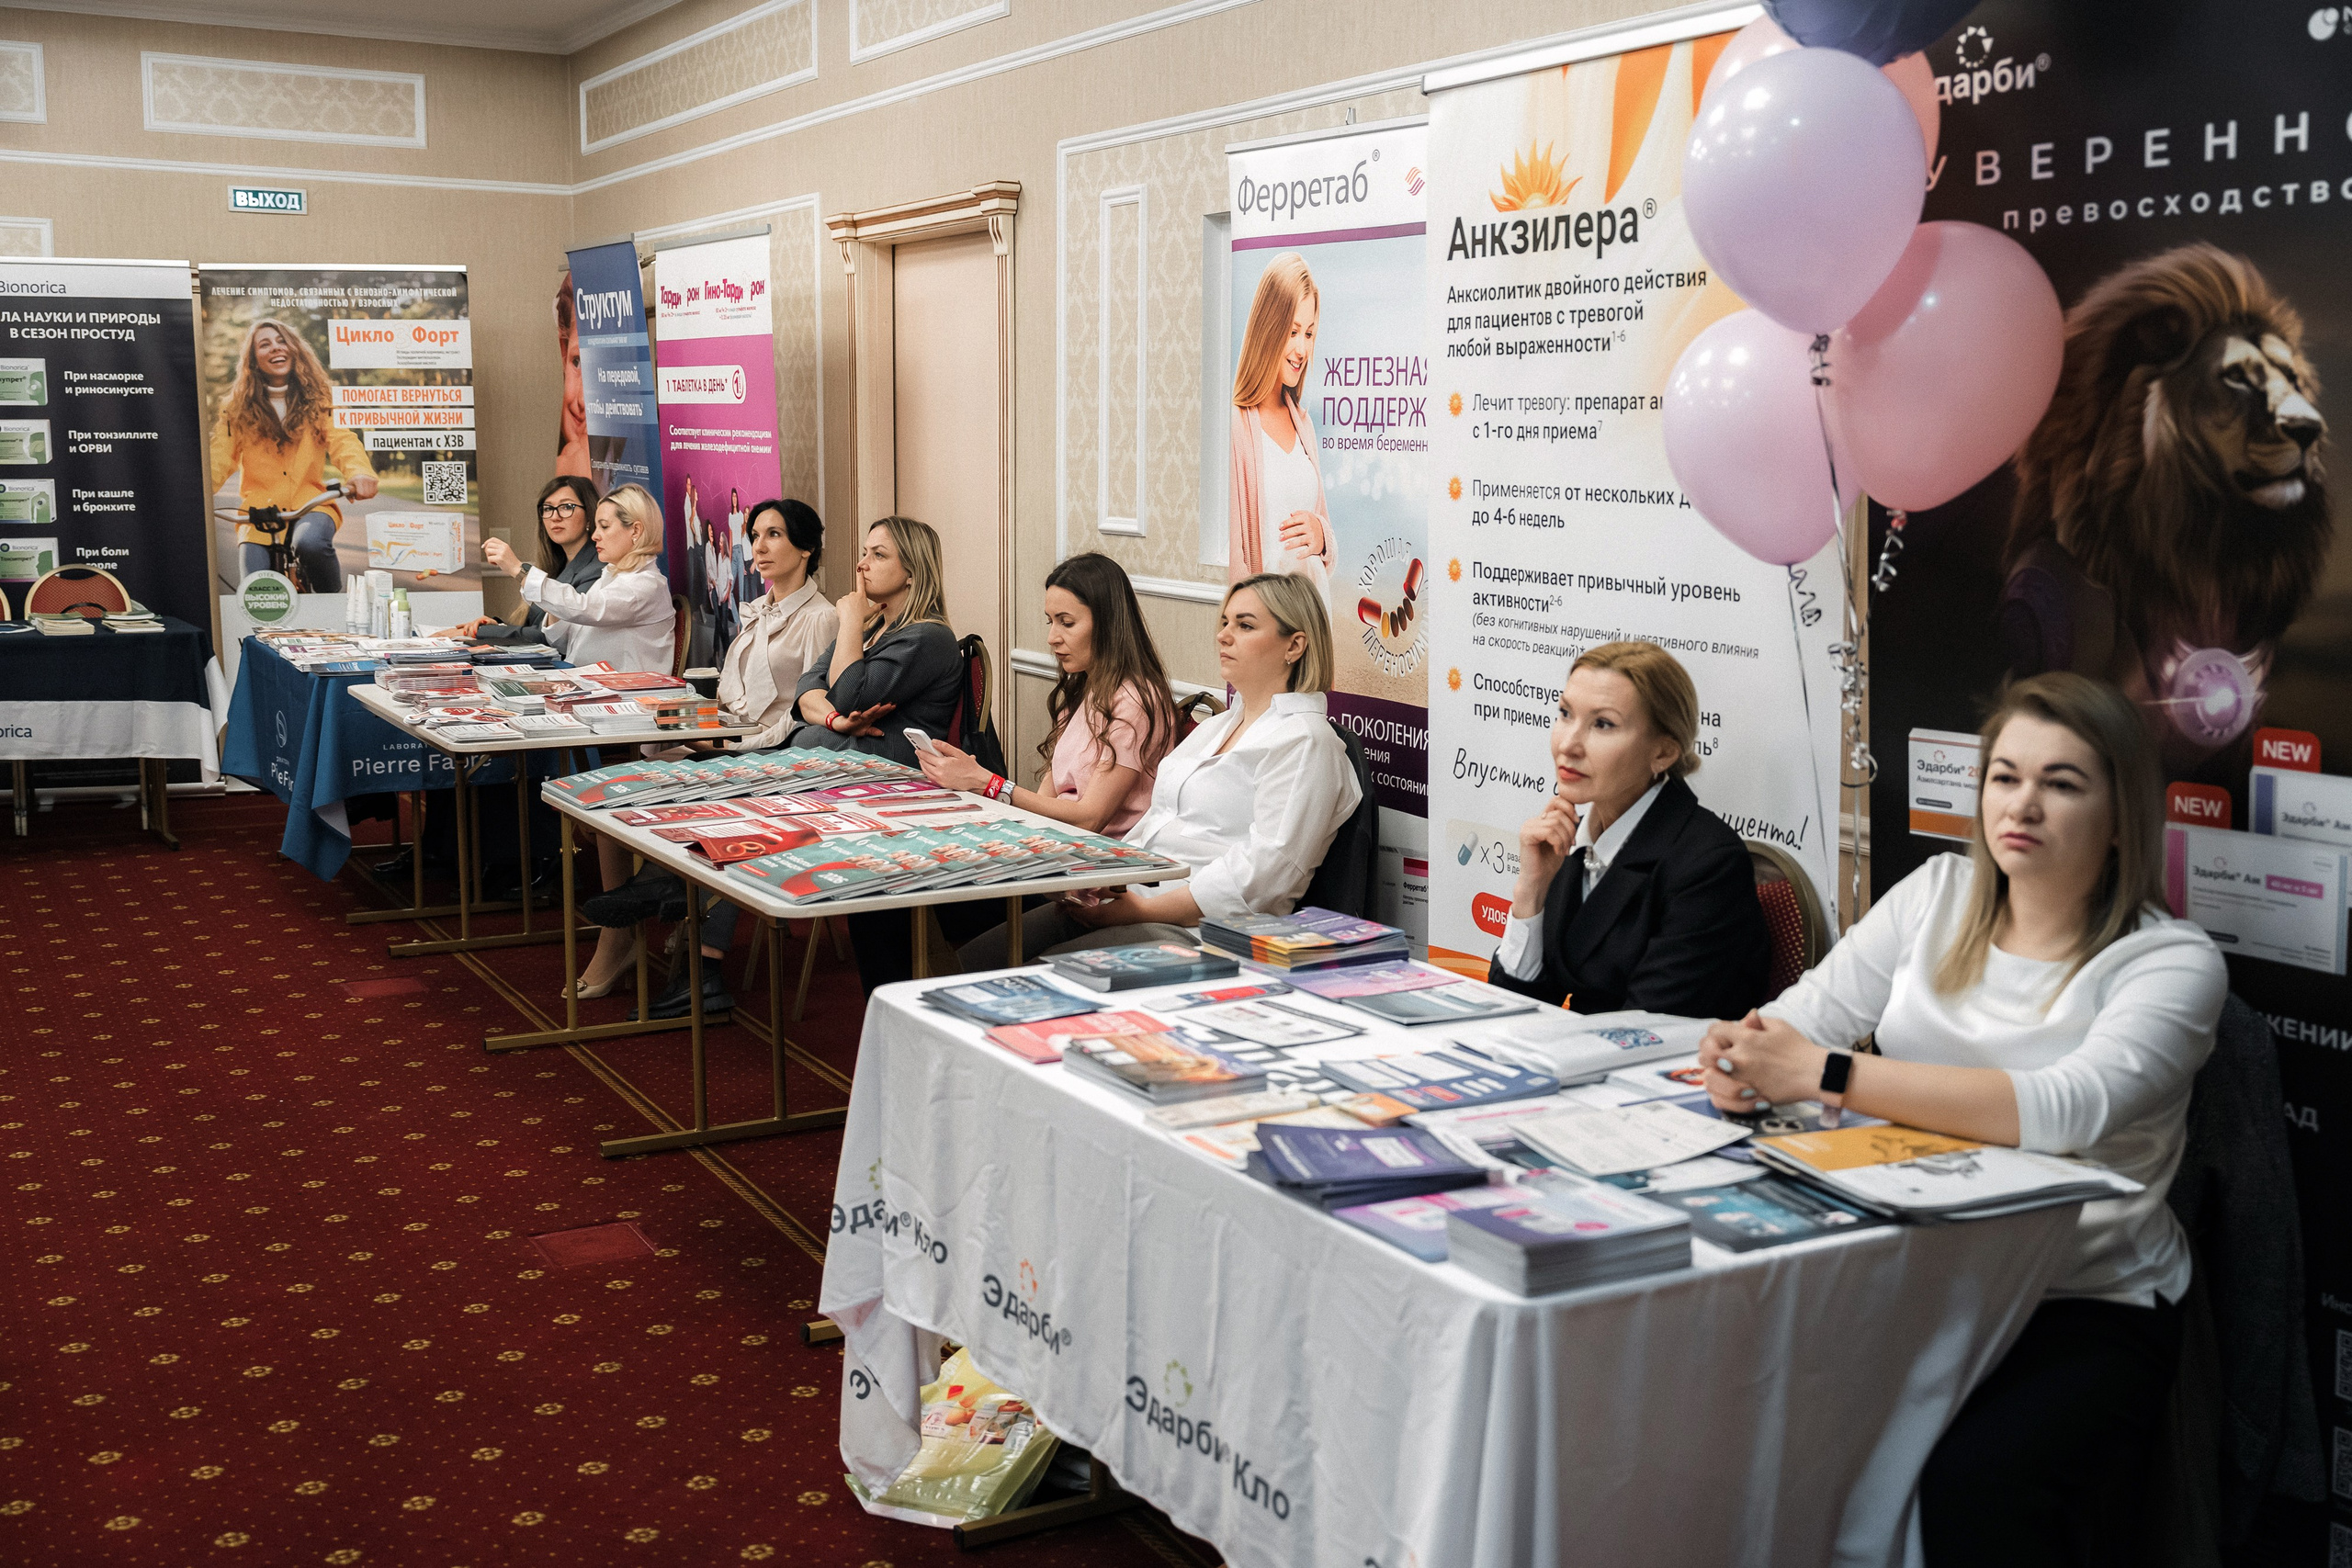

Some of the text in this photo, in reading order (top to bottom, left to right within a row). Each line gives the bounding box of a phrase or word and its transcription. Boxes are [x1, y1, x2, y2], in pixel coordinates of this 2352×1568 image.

[1926, 111, 2352, 191] УВЕРЕНН
[235, 191, 300, 210] ВЫХОД
[1447, 197, 1657, 261] Анкзилера®
[211, 287, 458, 298] ЛЕЧЕНИЕ СИМПТОМОВ, СВЯЗАННЫХ С ВЕНОЗНО-ЛИМФАТИЧЕСКОЙ
[1447, 269, 1707, 304] Анксиолитик двойного действия
[271, 299, 349, 308] НЕДОСТАТОЧНОСТЬЮ
[351, 299, 356, 308] У
[576, 288, 633, 330] Структум
[24, 311, 72, 322] НАУКИ
[75, 312, 86, 322] И
[89, 313, 161, 325] ПРИРОДЫ
[1447, 299, 1644, 333] для пациентов с тревогой
[10, 328, 135, 341] В СЕЗОН ПРОСТУД
[335, 326, 394, 345] Цикло
[413, 326, 458, 346] Форт
[1447, 338, 1491, 358] любой
[63, 371, 143, 382] При насморке
[597, 366, 640, 387] На передовой,
[666, 379, 670, 392] 1
[673, 378, 702, 392] ТАБЛЕТКА
[703, 378, 707, 391] В
[75, 386, 153, 397] риносинусите
[342, 389, 462, 402] ПОМОГАЕТ ВЕРНУТЬСЯ
[1473, 393, 1514, 412] Лечит
[1518, 397, 1570, 415] тревогу:
[1574, 395, 1645, 417] препарат
[339, 410, 463, 425] К ПРИВЫЧНОЙ ЖИЗНИ
[68, 430, 158, 441] При тонзиллите
[1473, 424, 1480, 439] с
[1484, 422, 1513, 439] 1-го
[1516, 424, 1539, 442] дня
[69, 444, 112, 453] и ОРВИ
[373, 437, 433, 449] пациентам
[436, 438, 441, 447] с
[1322, 436, 1335, 449] во
[1338, 437, 1374, 451] время
[73, 489, 134, 500] При кашле
[1473, 479, 1561, 501] Применяется
[1565, 487, 1581, 501] от
[1585, 487, 1675, 505] нескольких
[83, 502, 136, 513] бронхите
[1472, 507, 1565, 529] до 4-6 недель
[76, 547, 129, 558] При боли
[1472, 561, 1741, 603] Поддерживает привычный уровень
[245, 592, 288, 601] ВЫСОКИЙ
[1472, 613, 1496, 628] (без
[1498, 617, 1558, 637] когнитивных
[1560, 625, 1621, 642] нарушений
[1623, 632, 1631, 641] и
[1712, 643, 1759, 660] влияния
[1472, 635, 1486, 646] на
[1487, 637, 1531, 655] скорость
[1474, 704, 1551, 728] при приеме
[2262, 739, 2312, 763] NEW
[352, 758, 421, 776] Pierre
[1453, 748, 1544, 793] Впустите
[1377, 773, 1429, 796] состояни
[2174, 795, 2223, 818] NEW
[1233, 1453, 1290, 1519] Кло
